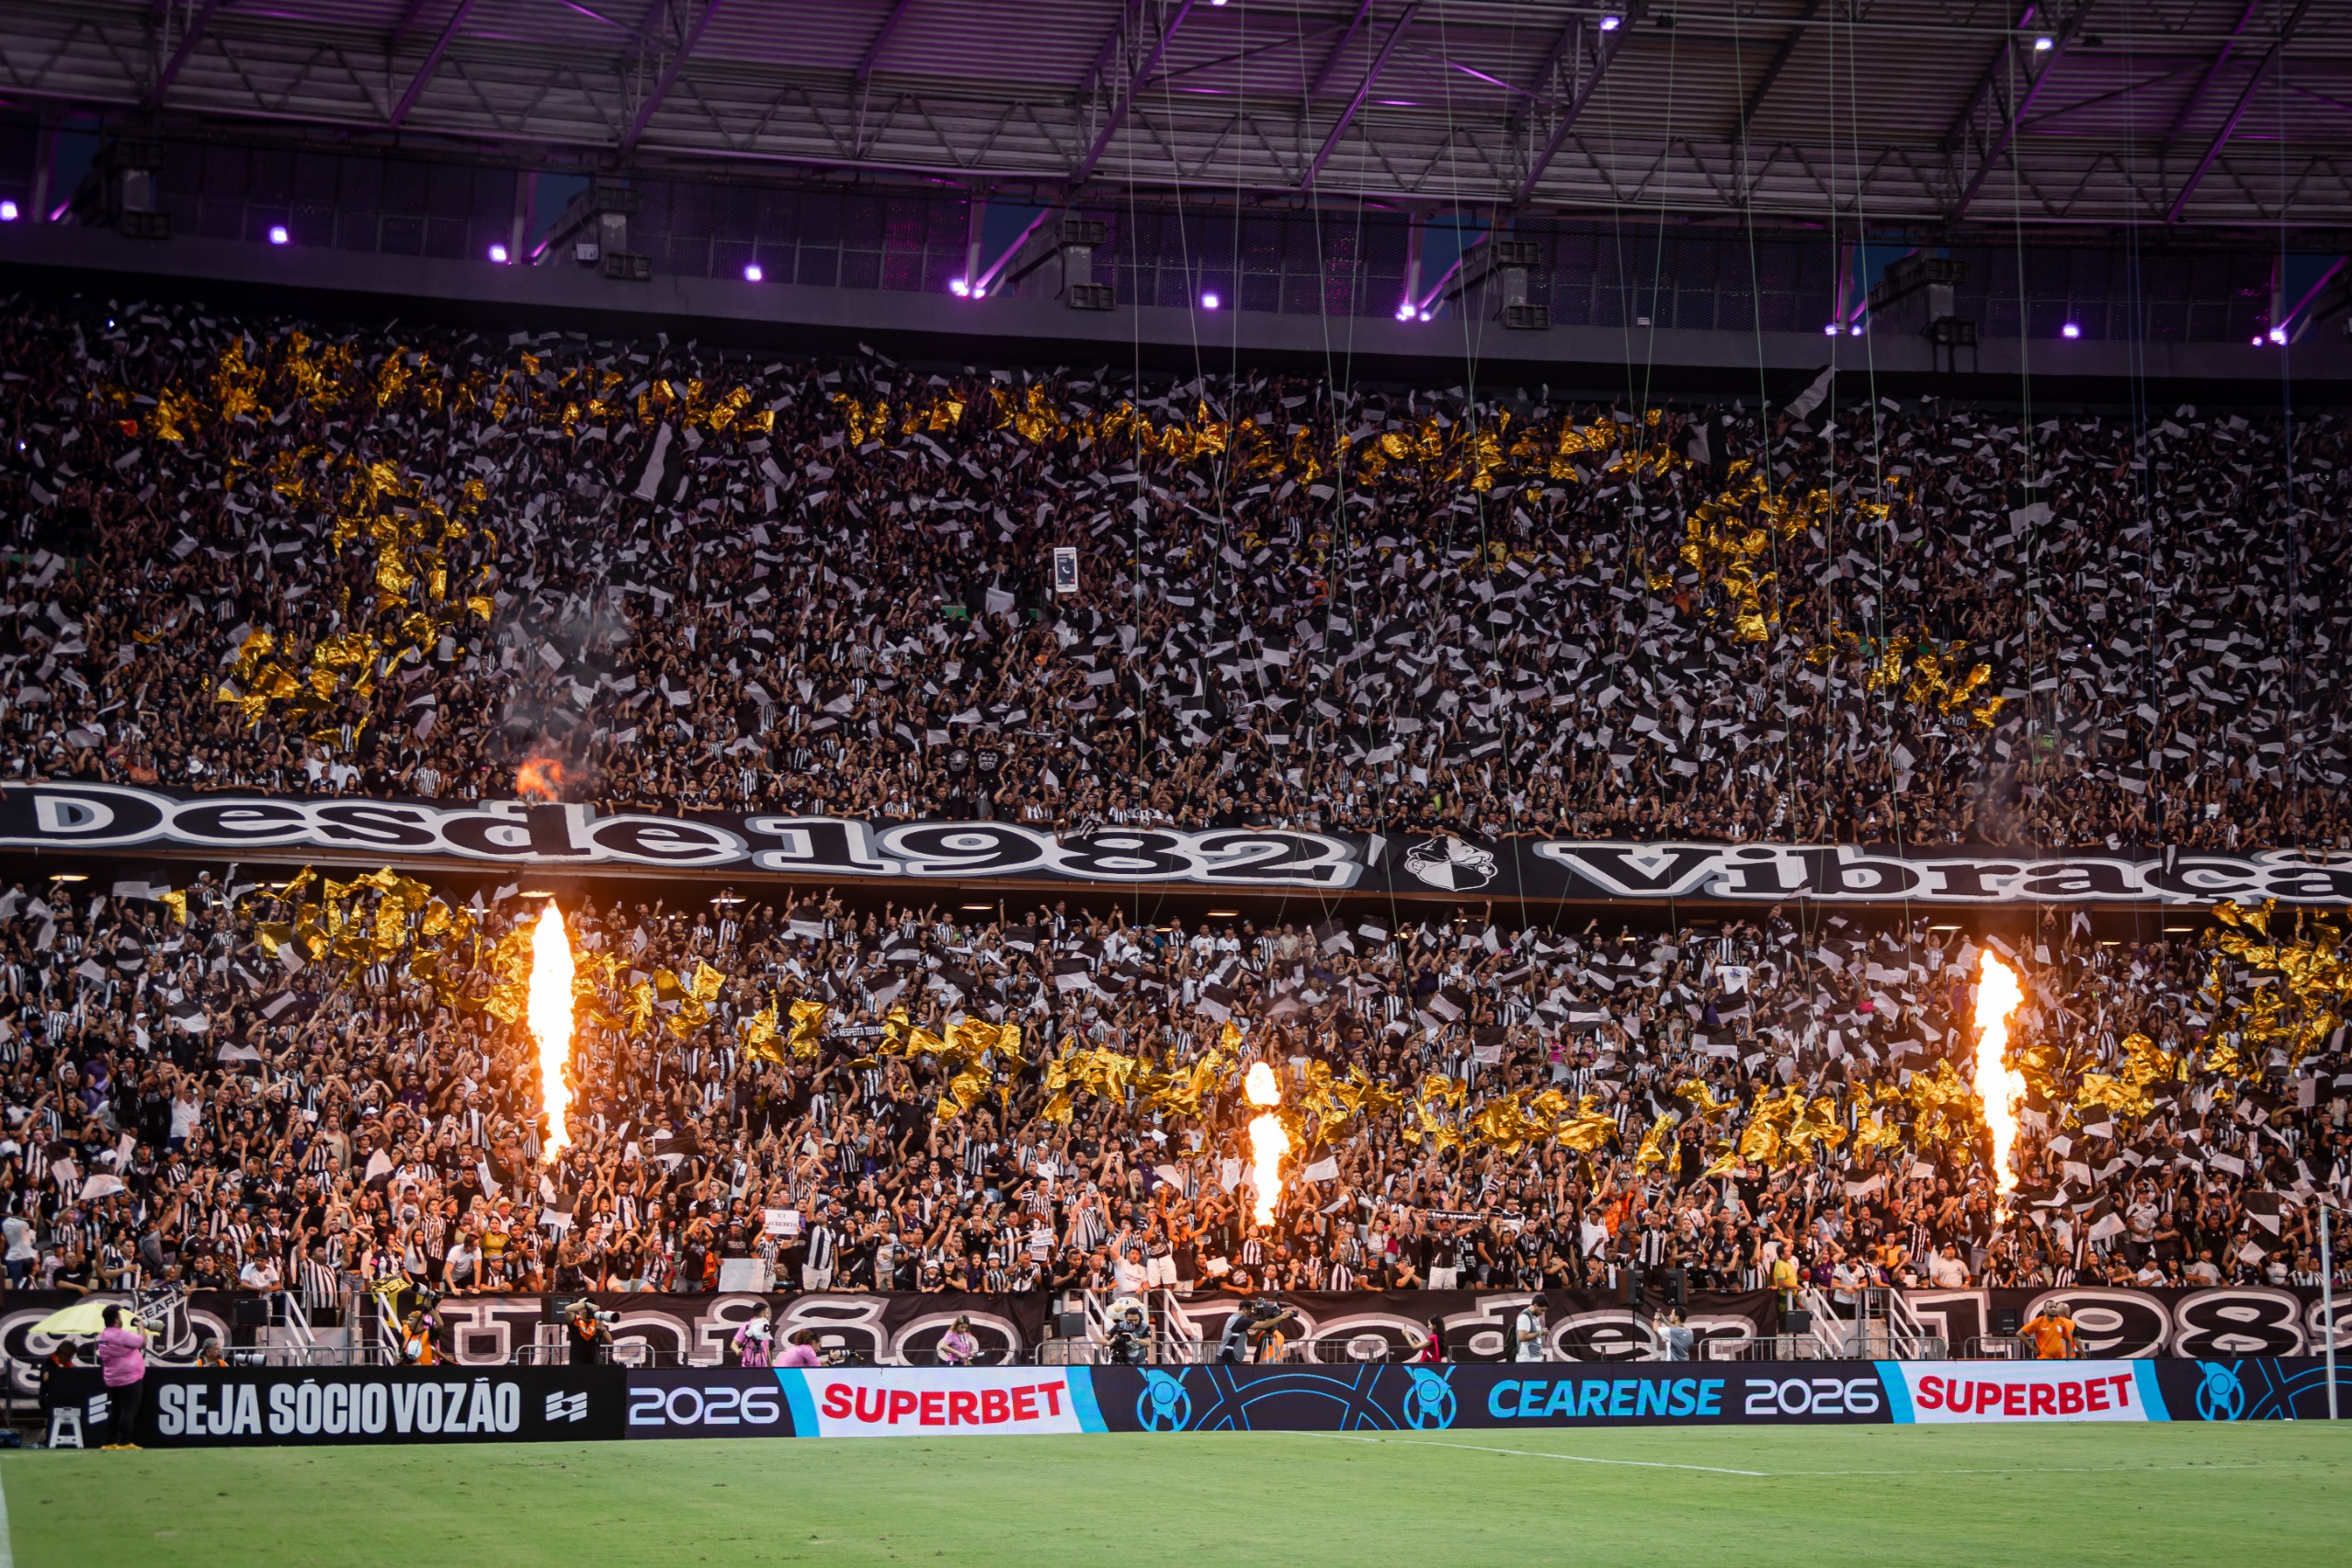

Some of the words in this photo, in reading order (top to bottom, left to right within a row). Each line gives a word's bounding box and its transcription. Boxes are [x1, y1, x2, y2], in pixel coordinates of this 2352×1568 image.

[0, 780, 747, 867] Desde
[744, 815, 1363, 889] 1982
[157, 1383, 263, 1436] SEJA
[268, 1378, 388, 1435] SÓCIO
[391, 1377, 521, 1434] VOZÃO
[629, 1387, 779, 1426] 2026
[821, 1380, 1066, 1427] SUPERBET
[1487, 1378, 1725, 1418] CEARENSE
[1744, 1377, 1880, 1415] 2026
[1915, 1372, 2133, 1416] SUPERBET
